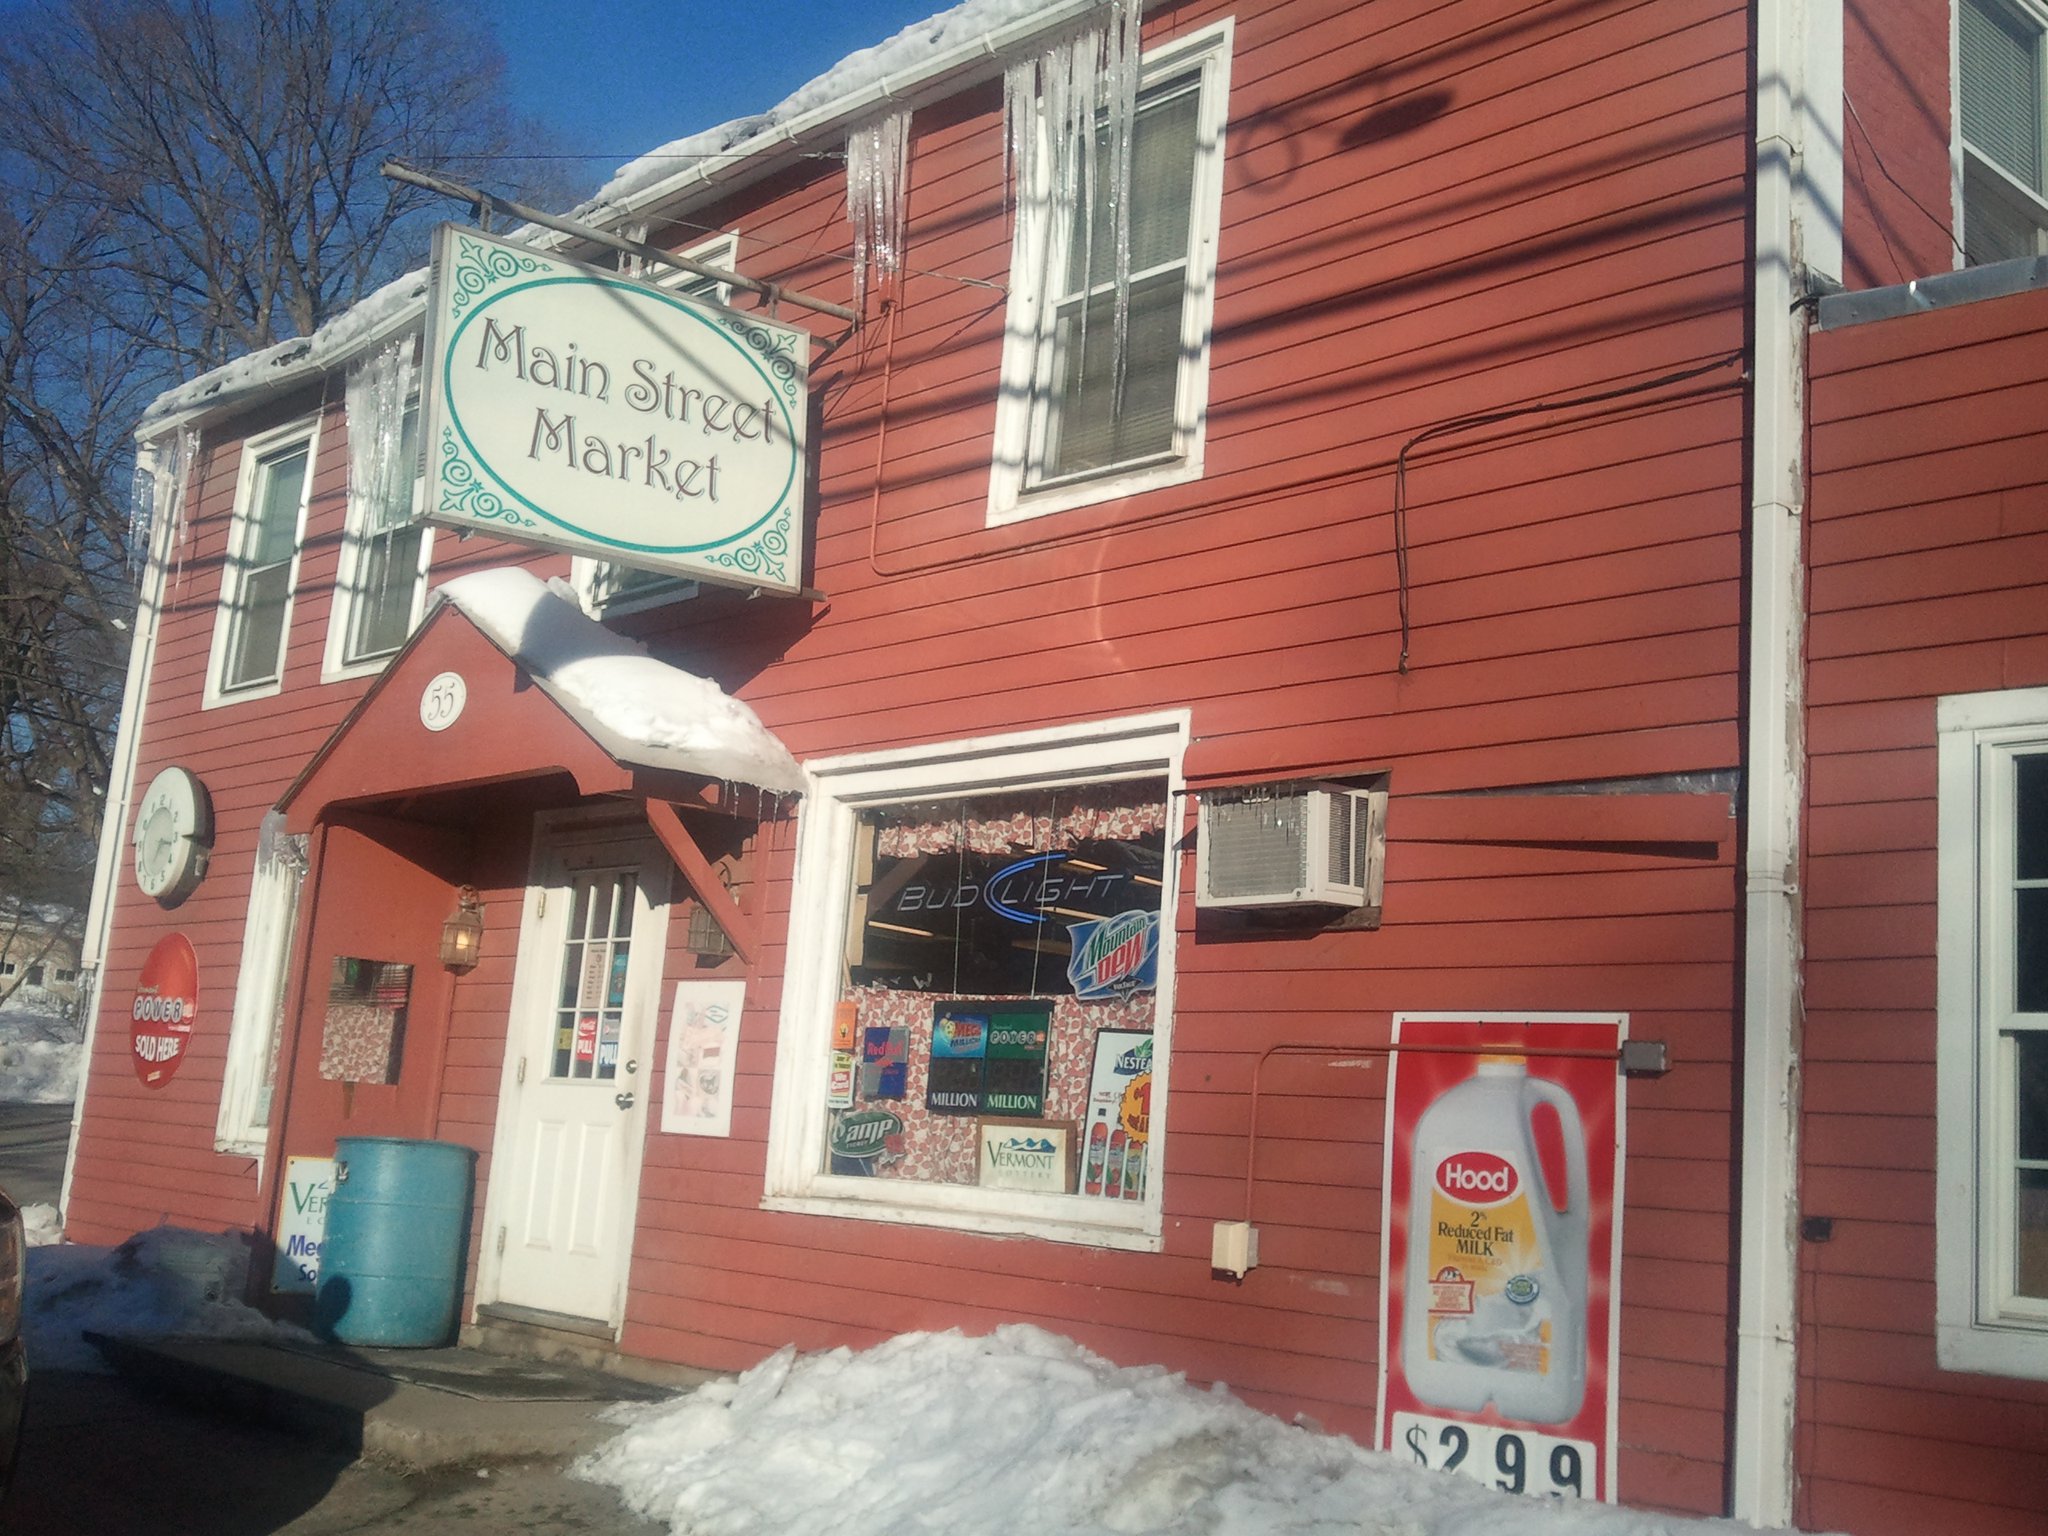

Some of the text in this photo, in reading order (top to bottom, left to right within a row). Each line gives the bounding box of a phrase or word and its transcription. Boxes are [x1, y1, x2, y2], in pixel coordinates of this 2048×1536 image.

[475, 317, 777, 445] Main Street
[527, 407, 722, 503] Market
[897, 874, 1124, 912] BUD LIGHT
[132, 996, 183, 1023] POWER
[135, 1035, 180, 1062] SOLD HERE
[990, 1031, 1037, 1044] POWER
[1115, 1054, 1153, 1070] NESTEA
[931, 1092, 978, 1107] MILLION
[987, 1094, 1037, 1110] MILLION
[1445, 1163, 1509, 1192] Hood
[1438, 1222, 1514, 1242] Reduced Fat
[1456, 1239, 1494, 1256] MILK
